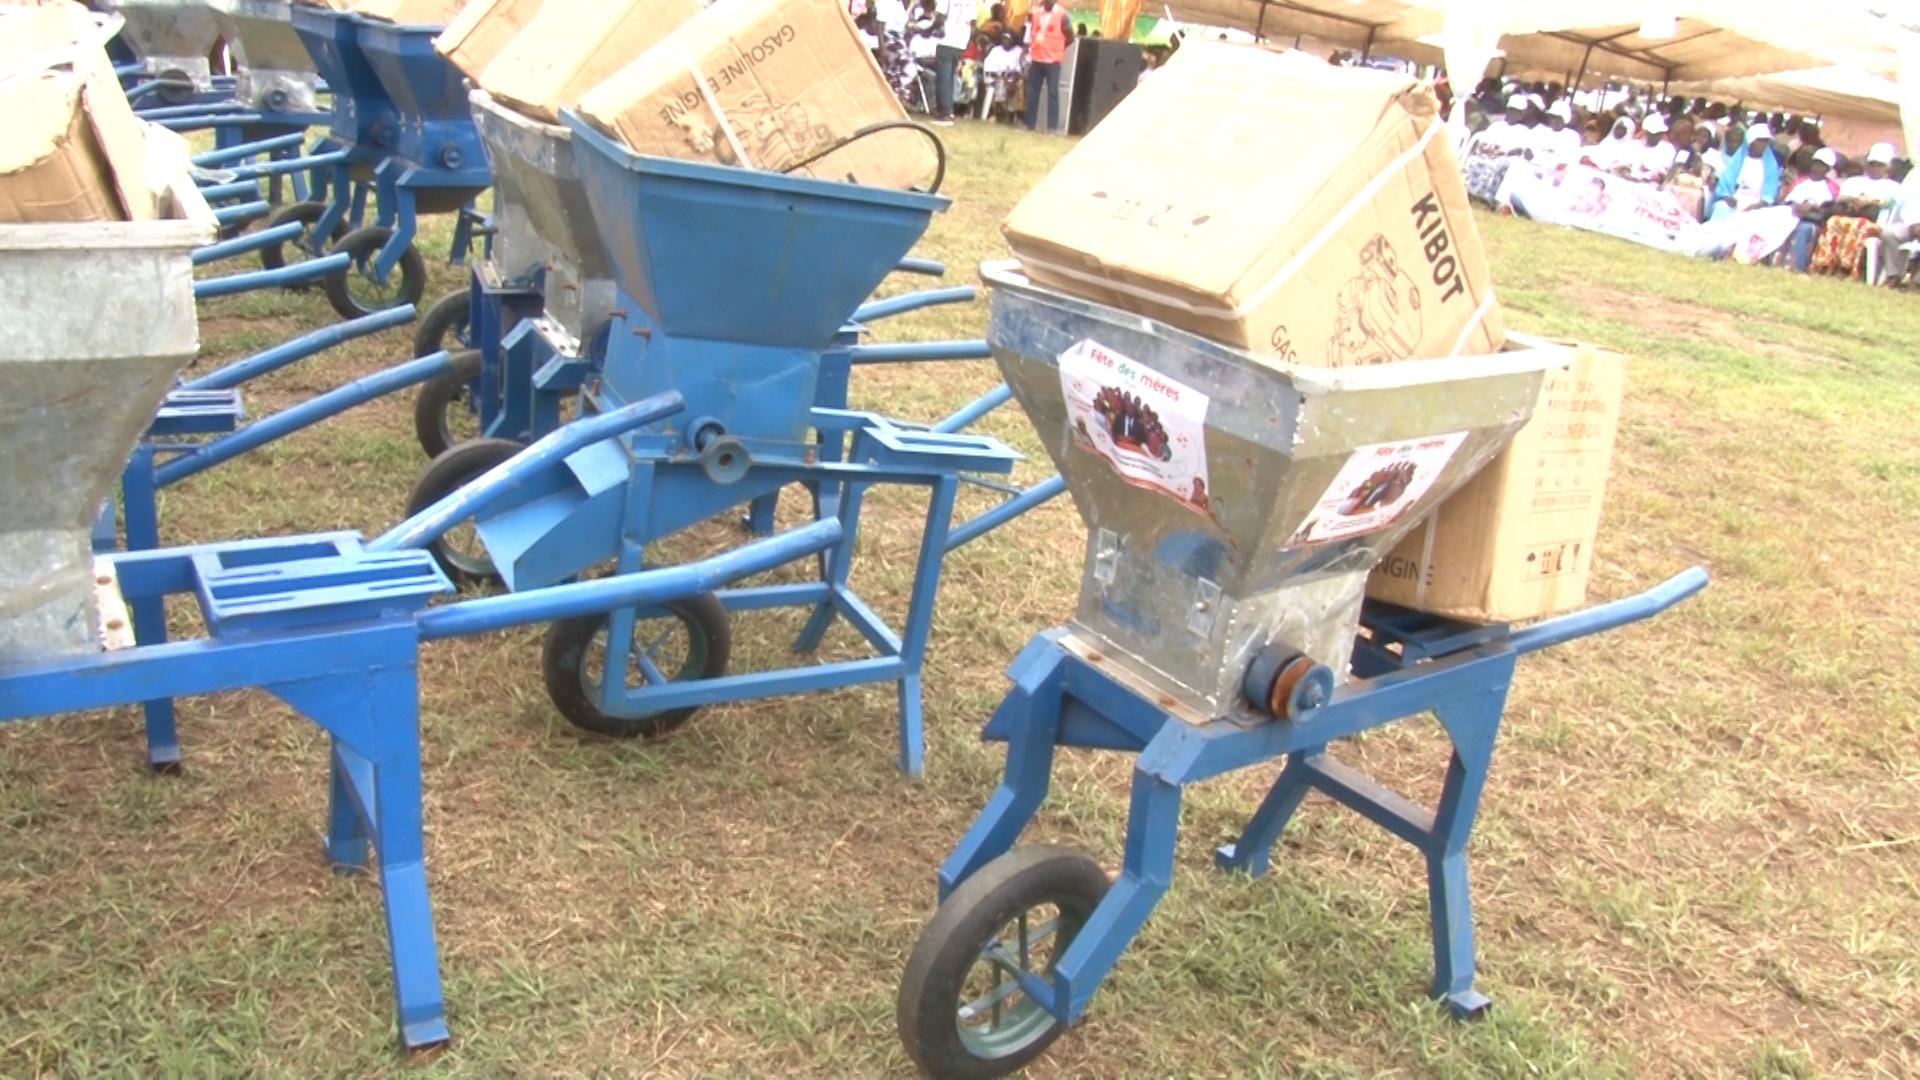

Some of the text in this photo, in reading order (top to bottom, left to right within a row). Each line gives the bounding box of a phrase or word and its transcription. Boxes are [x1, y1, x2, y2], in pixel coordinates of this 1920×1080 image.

[718, 24, 796, 86] GASOLINE
[1410, 191, 1465, 304] KIBOT
[1117, 363, 1136, 380] des
